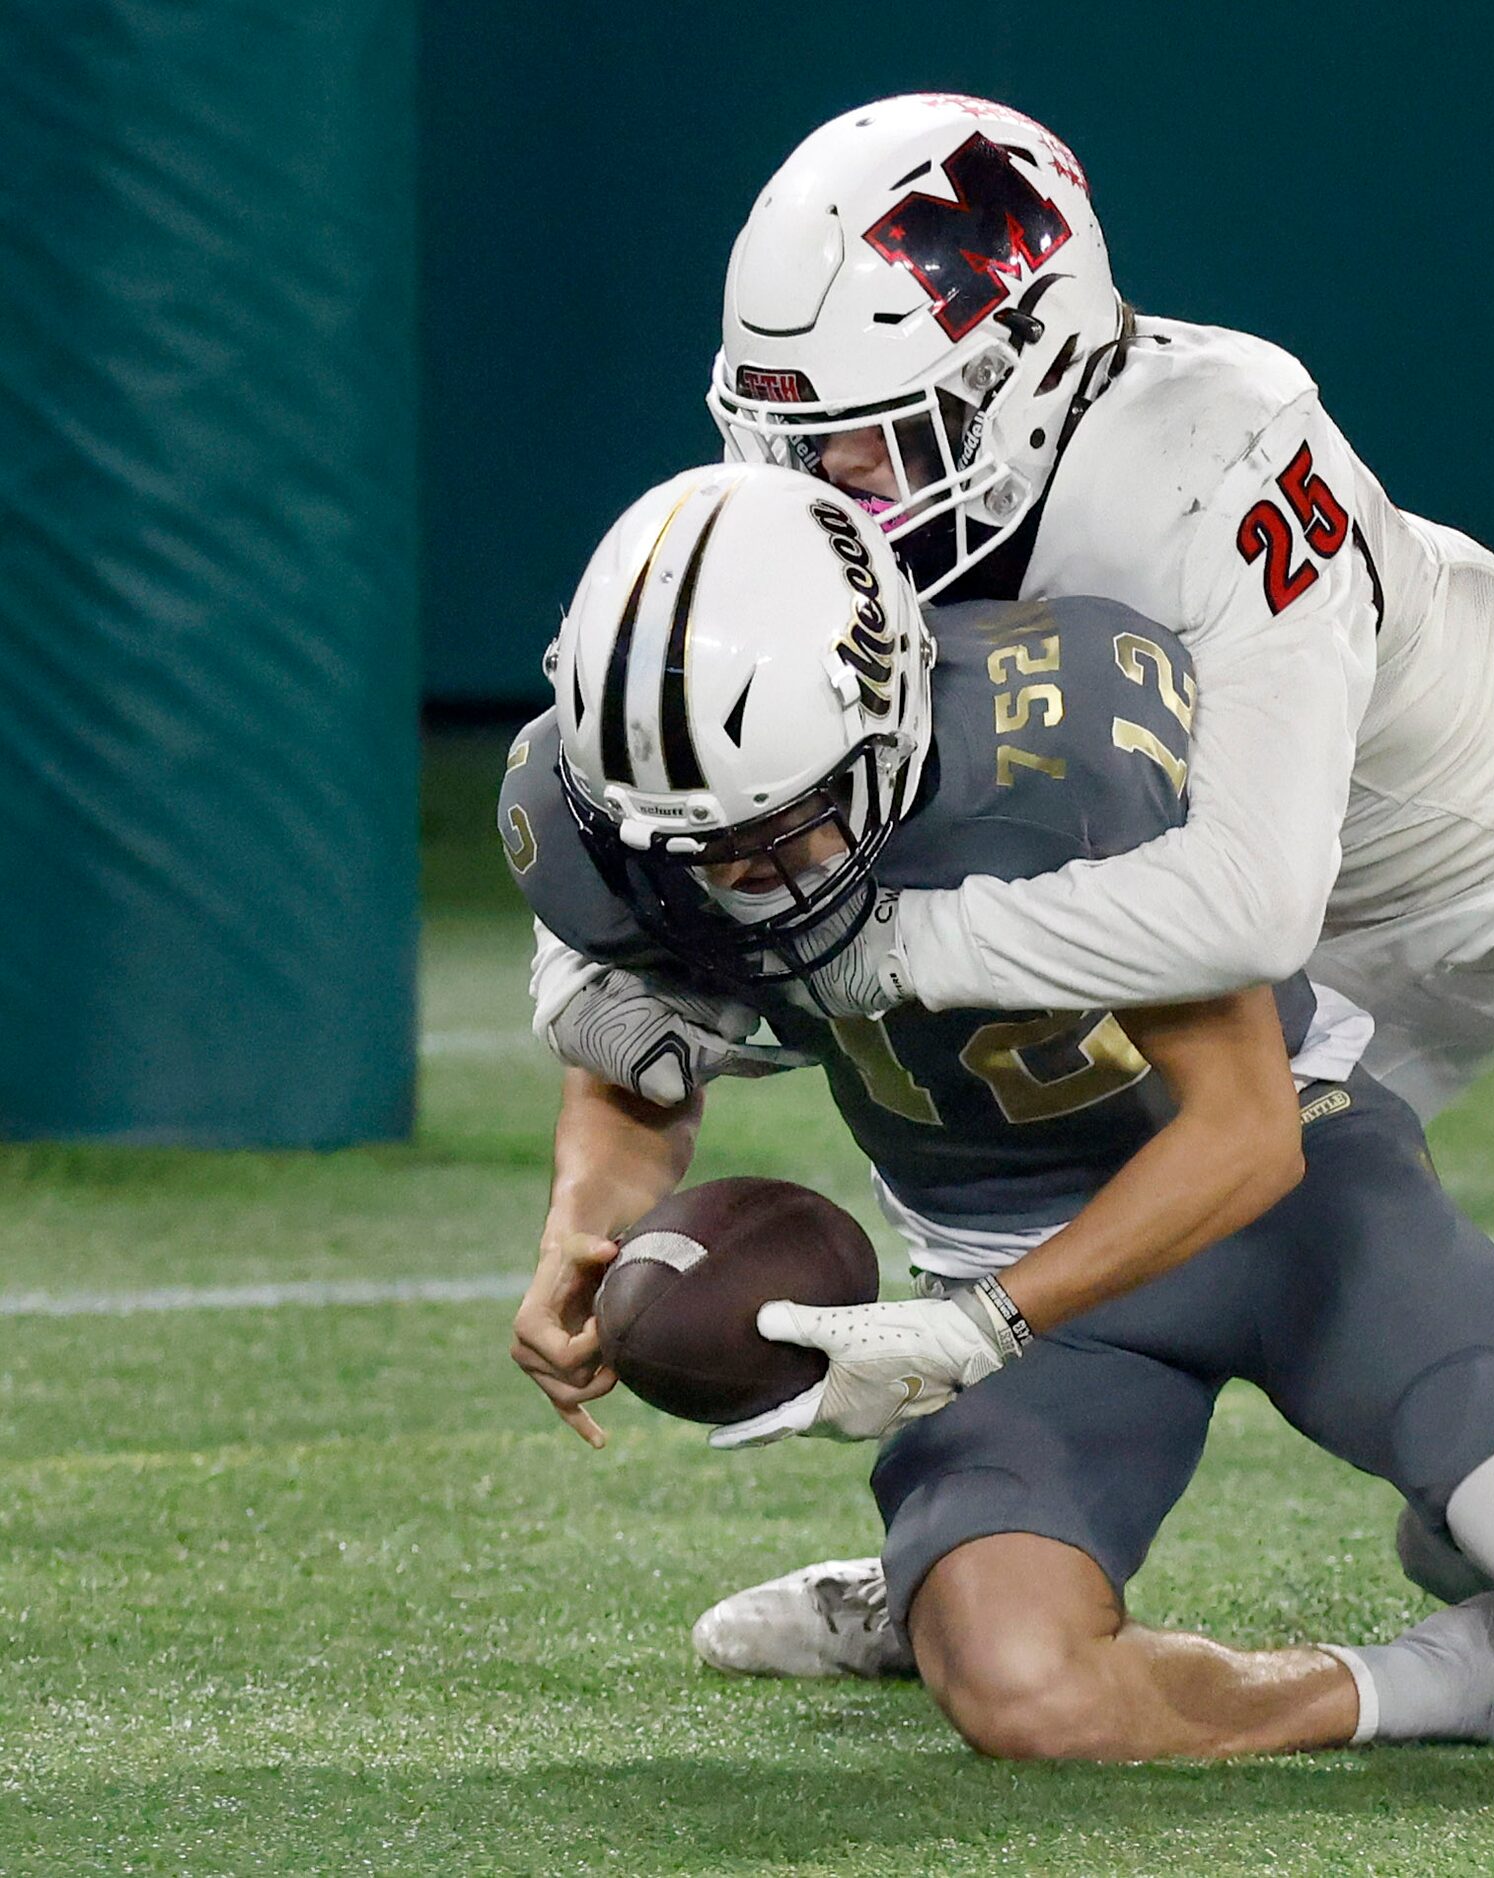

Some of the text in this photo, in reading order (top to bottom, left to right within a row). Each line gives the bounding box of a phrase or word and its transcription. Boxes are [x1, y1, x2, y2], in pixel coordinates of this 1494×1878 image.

[861, 131, 1072, 343] M
[1236, 439, 1348, 616] 25
[1111, 631, 1198, 799] 12
[1300, 1094, 1347, 1125] ATTLE
